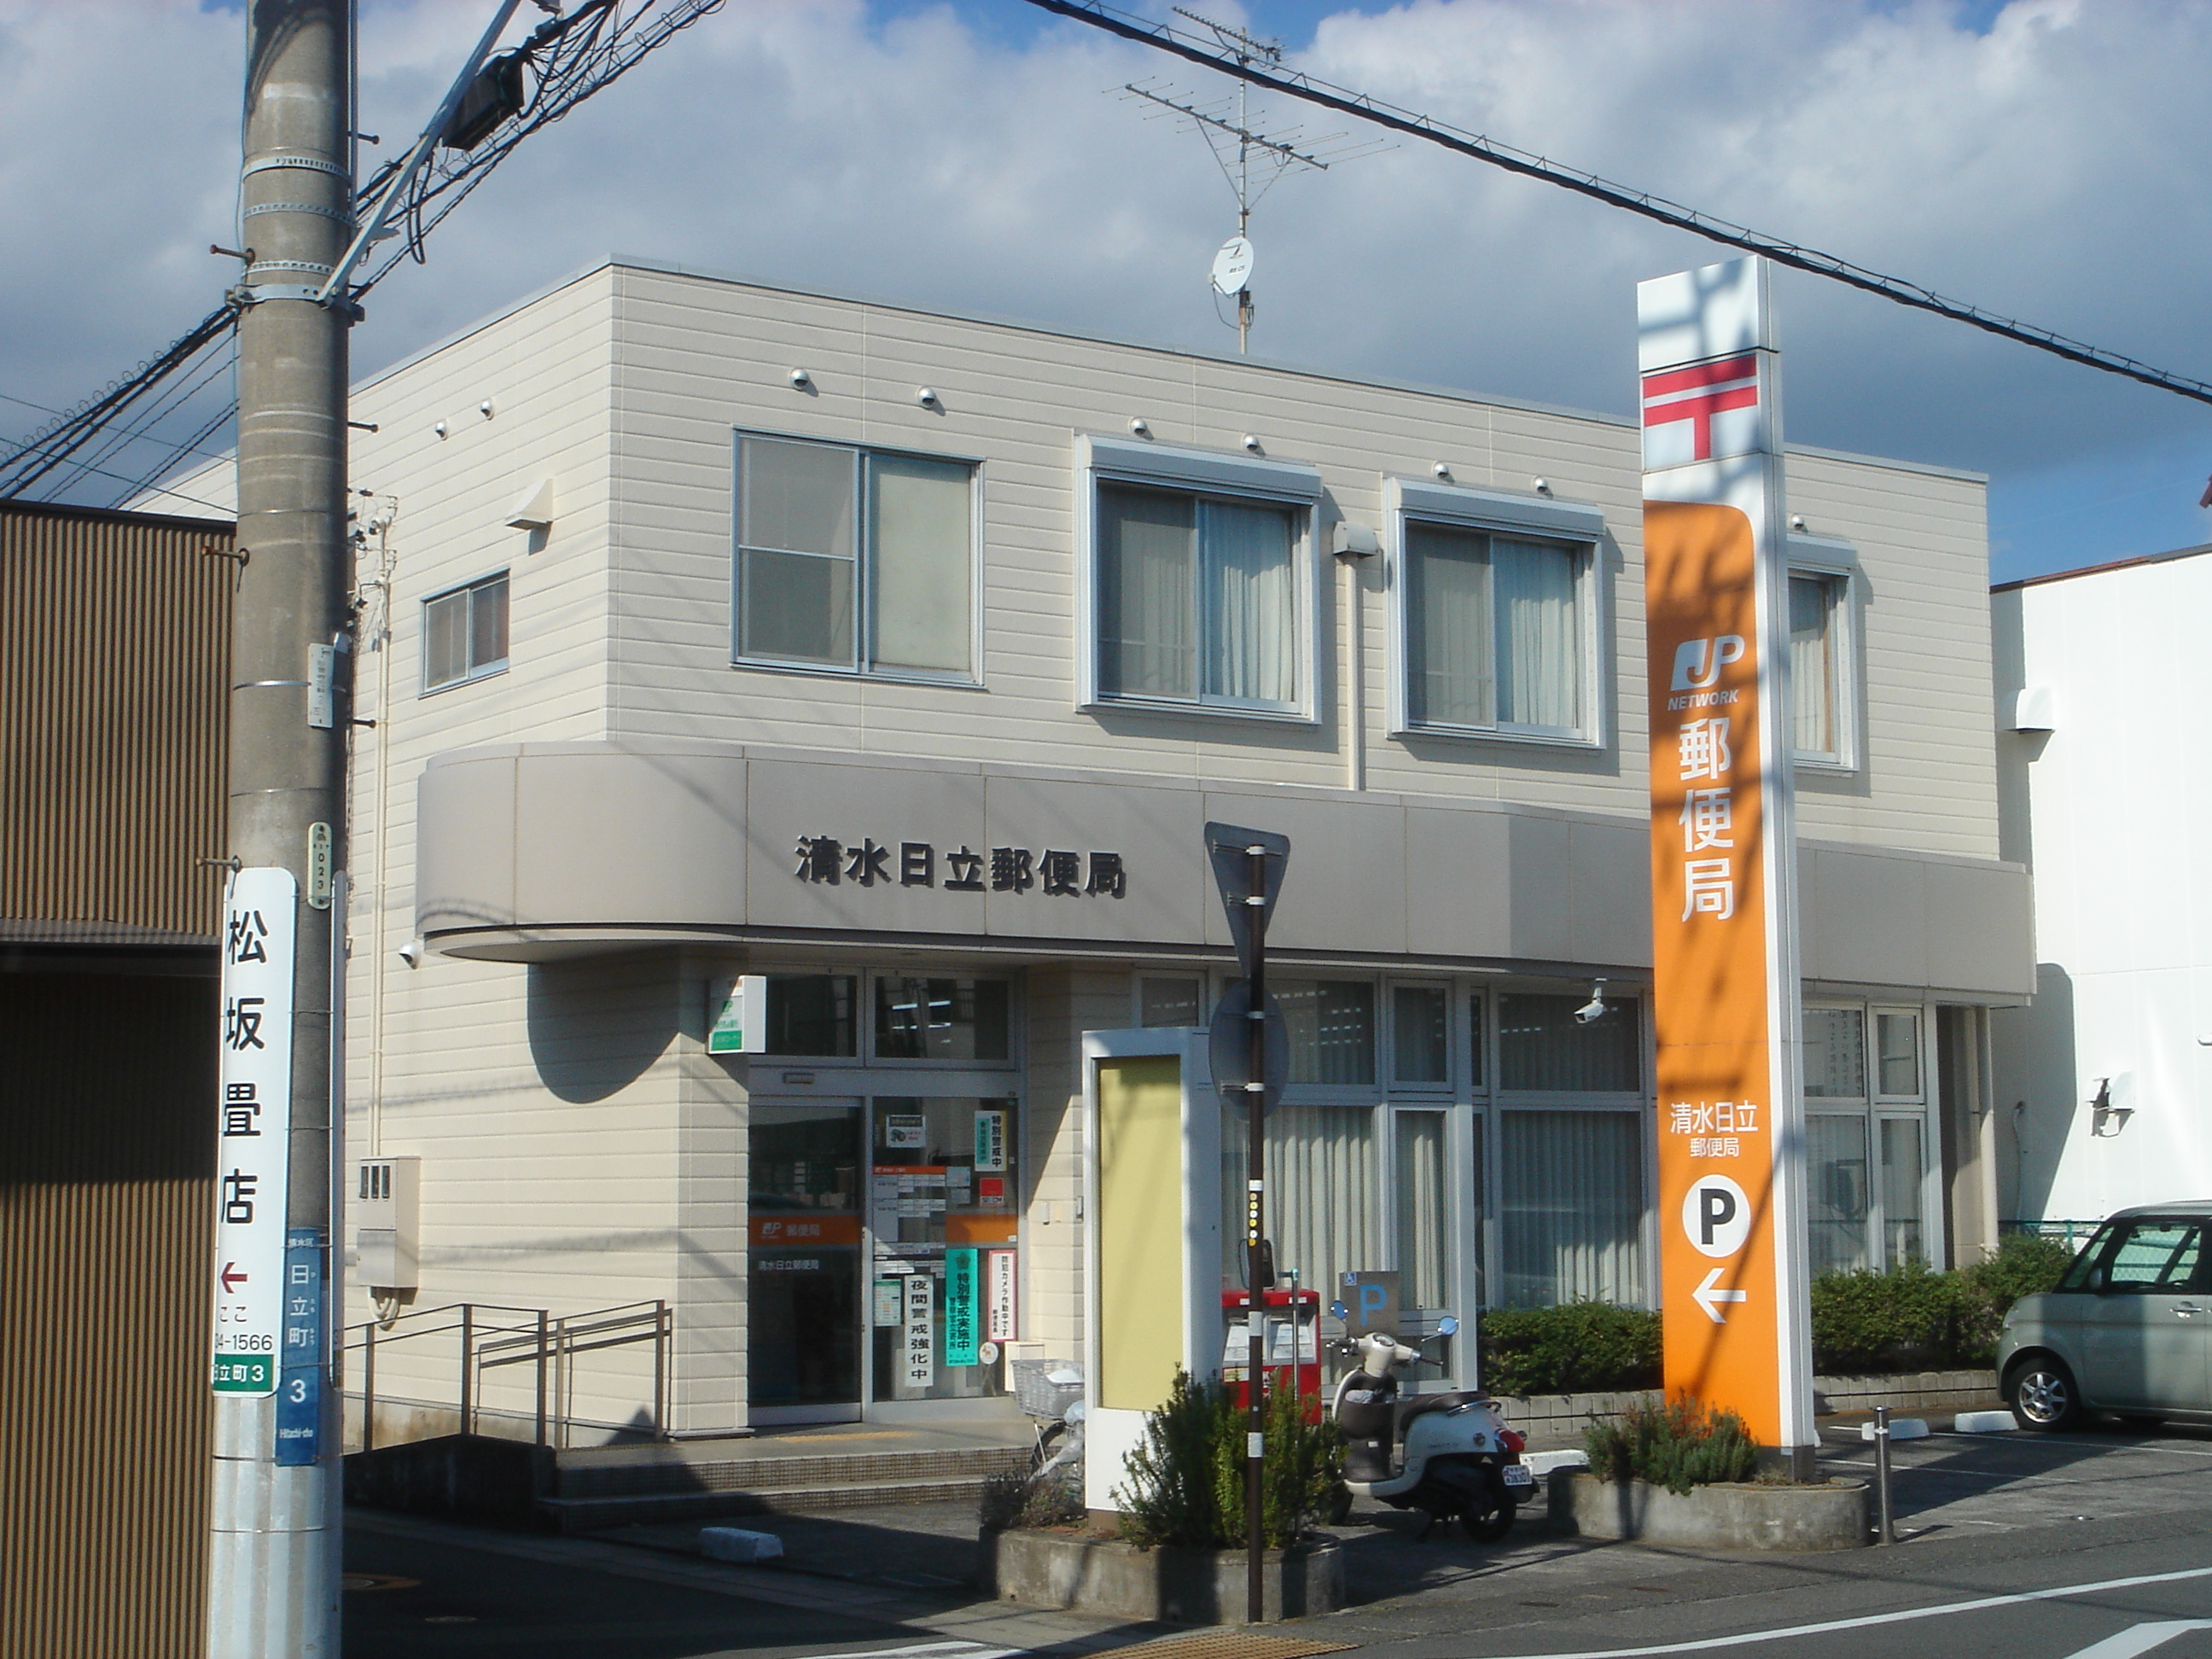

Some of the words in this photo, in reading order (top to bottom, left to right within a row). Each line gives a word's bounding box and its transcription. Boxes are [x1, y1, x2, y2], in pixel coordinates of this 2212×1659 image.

[1668, 689, 1739, 711] NETWORK
[1678, 718, 1734, 923] 郵便局
[795, 834, 1126, 899] 清水日立郵便局
[220, 909, 269, 1224] 松坂畳店
[1670, 1099, 1759, 1134] 清水日立
[1689, 1137, 1740, 1157] 郵便局
[1700, 1188, 1736, 1245] P
[220, 1307, 247, 1322] ここ
[288, 1265, 308, 1347] 日立町
[1359, 1284, 1387, 1325] P
[911, 1280, 929, 1380] 夜間警戒強化中
[289, 1379, 306, 1403] 3
